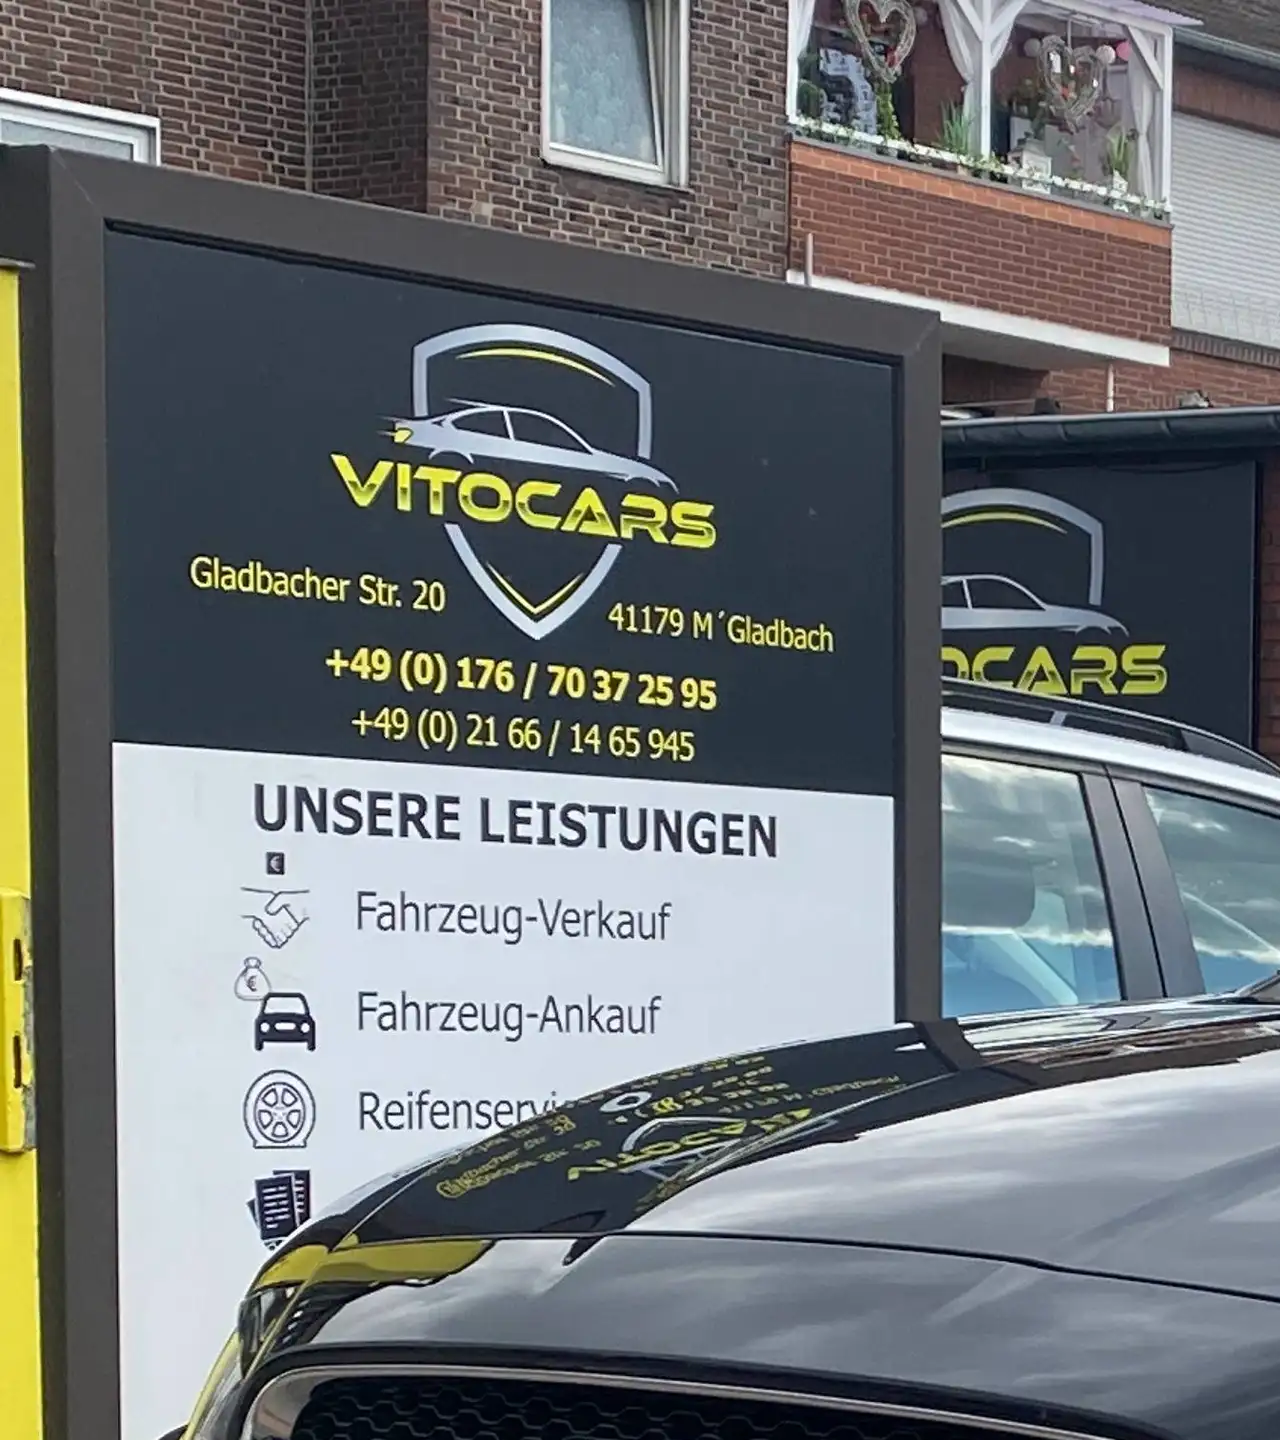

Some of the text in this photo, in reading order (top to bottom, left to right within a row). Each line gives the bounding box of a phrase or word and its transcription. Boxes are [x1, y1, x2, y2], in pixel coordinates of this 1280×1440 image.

[330, 453, 717, 549] VITOCARS
[189, 556, 446, 612] Gladbacher Str. 20
[608, 602, 685, 637] 41179
[325, 647, 717, 711] +49 (0) 176 / 70 37 25 95
[352, 706, 695, 762] +49 (0) 21 66 / 14 65 945
[254, 784, 777, 858] UNSERE LEISTUNGEN
[356, 890, 672, 945] Fahrzeug-Verkauf
[357, 990, 662, 1042] Fahrzeug-Ankauf
[358, 1089, 577, 1130] Reifenservi
